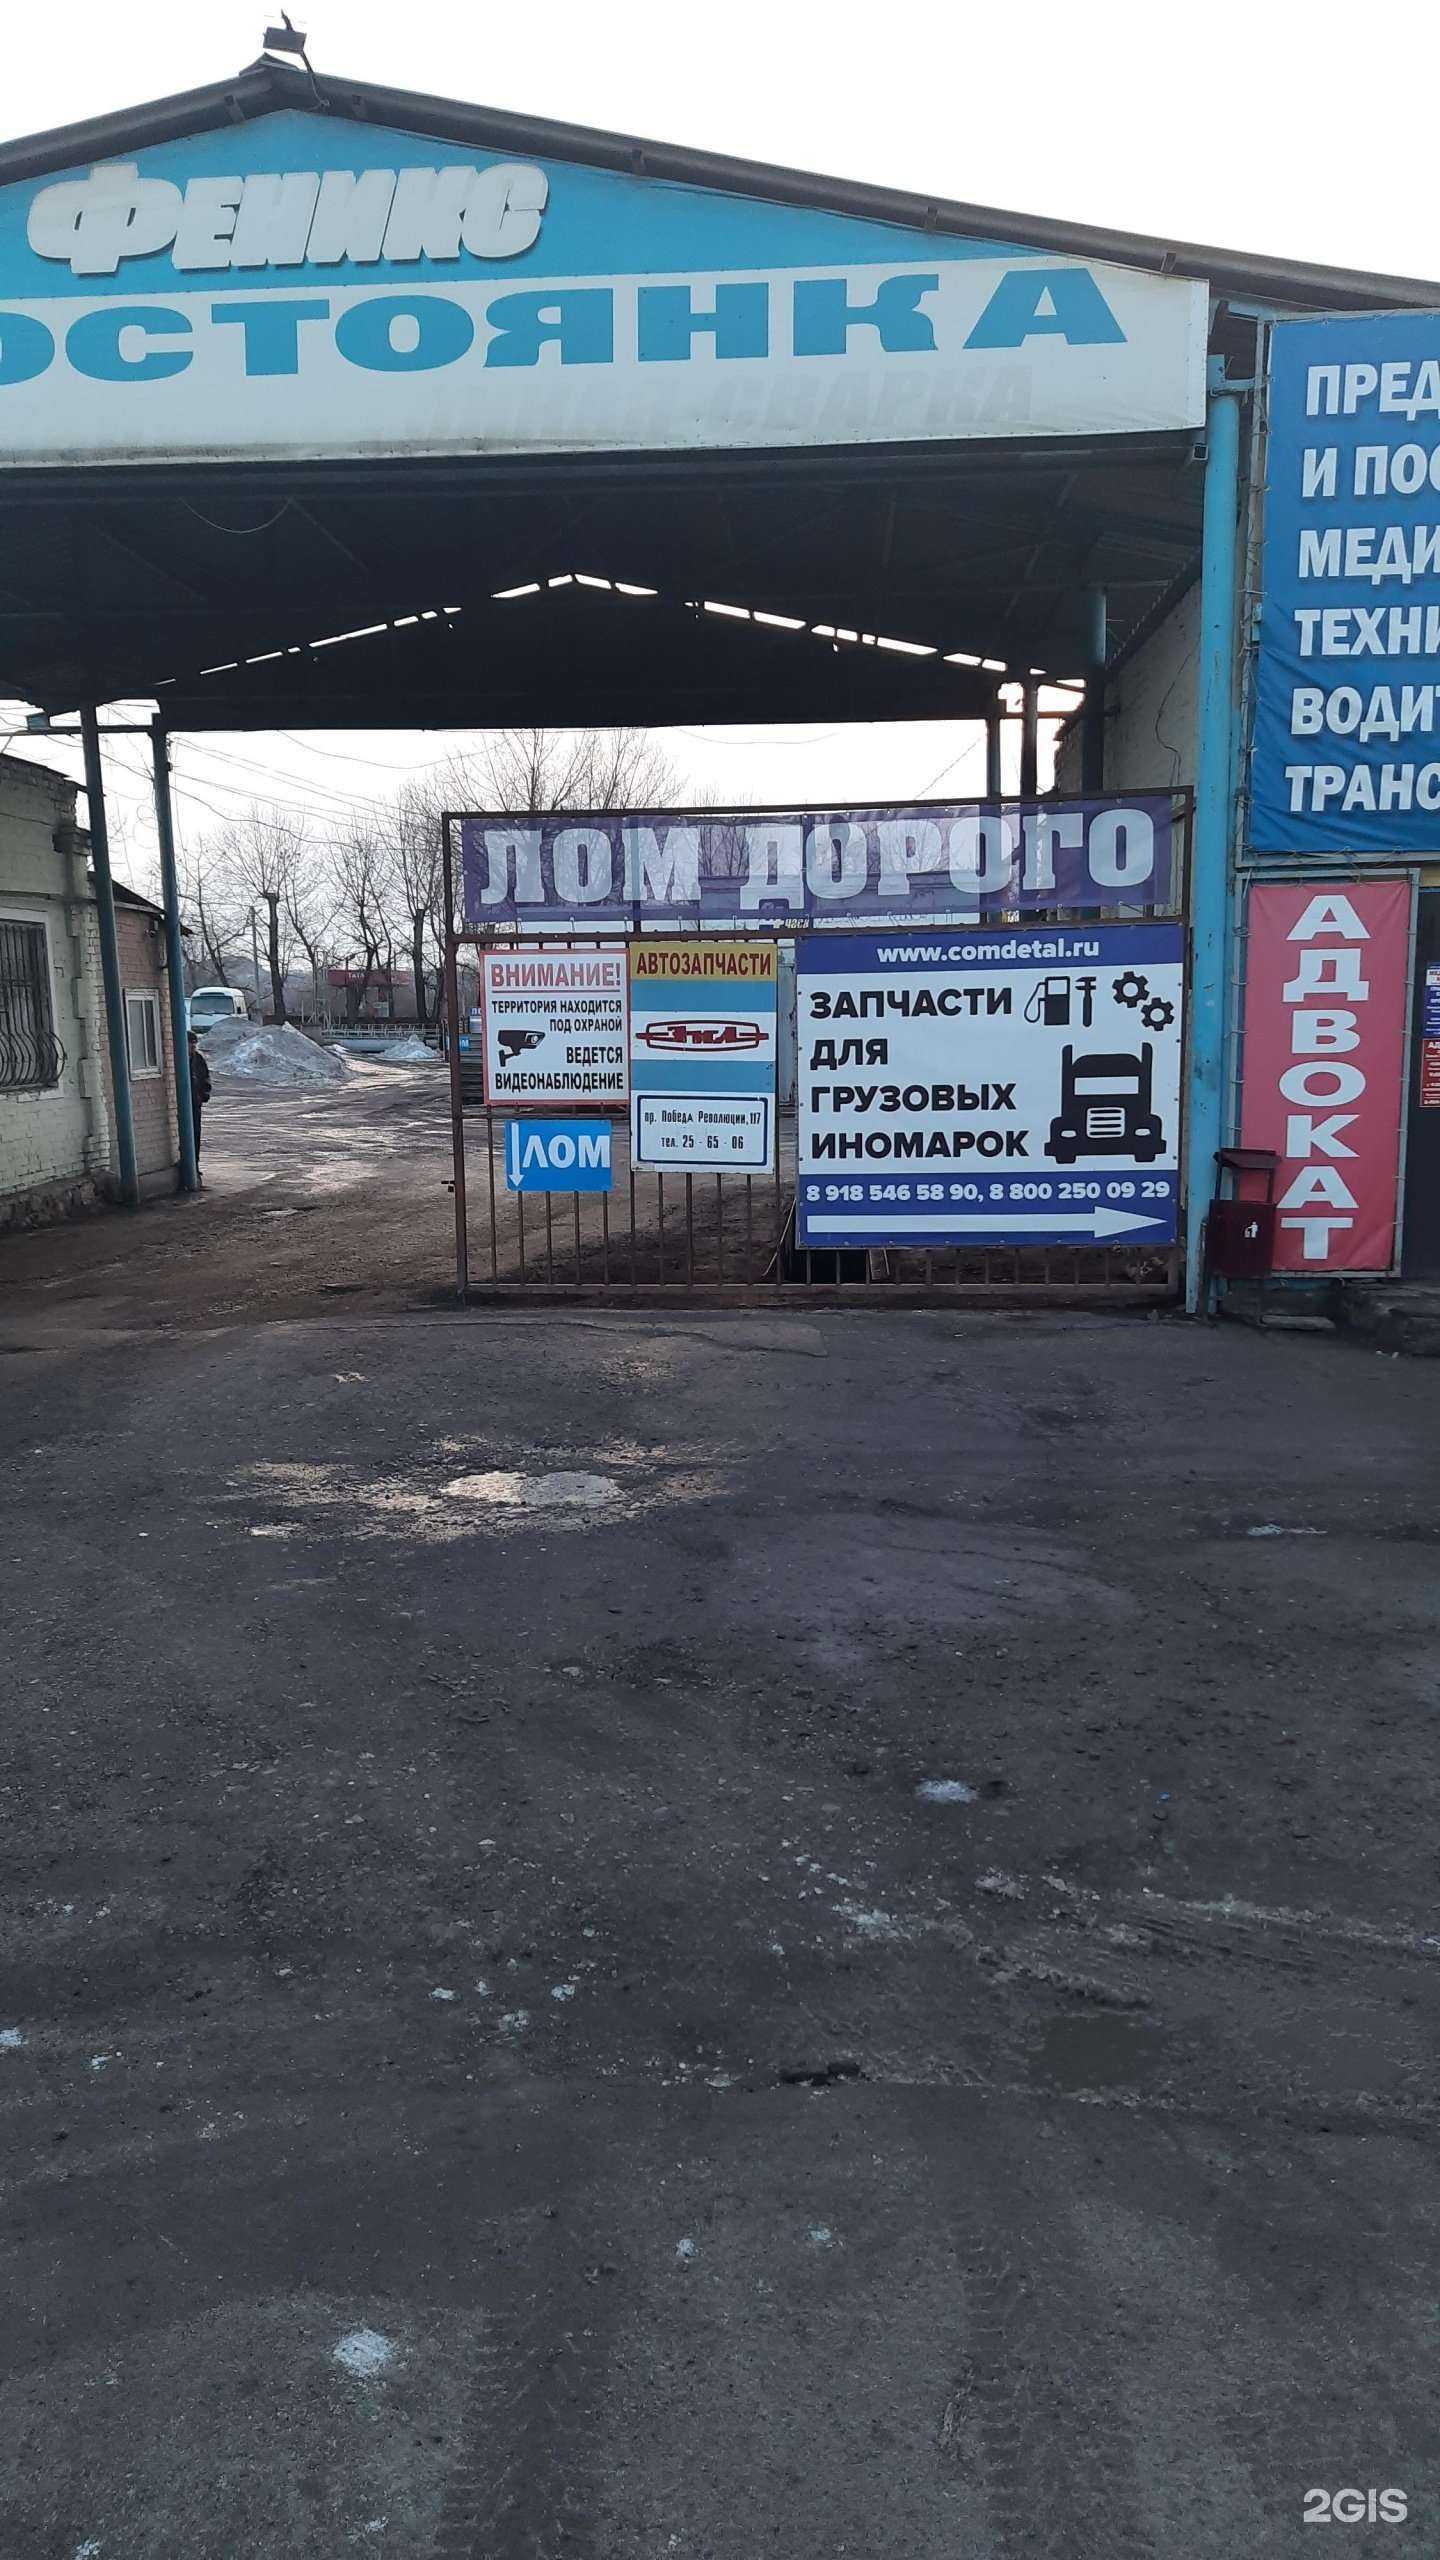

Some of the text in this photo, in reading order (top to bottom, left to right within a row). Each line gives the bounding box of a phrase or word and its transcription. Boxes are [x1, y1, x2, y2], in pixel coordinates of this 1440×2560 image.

[27, 162, 549, 274] ФЕНИКС
[1302, 447, 1338, 497] И
[1290, 685, 1440, 743] ВОДИ
[480, 808, 1155, 911] ЛОМ ДОРОГО
[636, 952, 771, 977] АВТОЗАПЧАСТИ
[877, 937, 1100, 964] www.comdetal.ru
[490, 962, 621, 987] ВНИМАНИЕ!
[491, 1000, 557, 1014] ТЕРРИТОРИЯ
[560, 999, 622, 1016] НАХОДИТСЯ
[809, 988, 1012, 1019] ЗАПЧАСТИ
[549, 1016, 623, 1034] ПОД ОХРАНОЙ
[566, 1046, 623, 1067] ВЕДЕТСЯ
[809, 1038, 889, 1071] ДЛЯ
[495, 1072, 624, 1093] ВИДЕОНАБЛЮДЕНИЕ
[1275, 894, 1372, 1260] АДВОКАТ
[810, 1083, 1017, 1113] ГРУЗОВЫХ
[522, 1134, 611, 1169] ЛОМ
[660, 1136, 679, 1148] тел.
[682, 1134, 695, 1149] 25
[706, 1135, 719, 1149] 65
[810, 1130, 1030, 1160] ИНОМАРОК
[806, 1181, 1170, 1203] 8 918 546 58 90, 8 800 250 09 29
